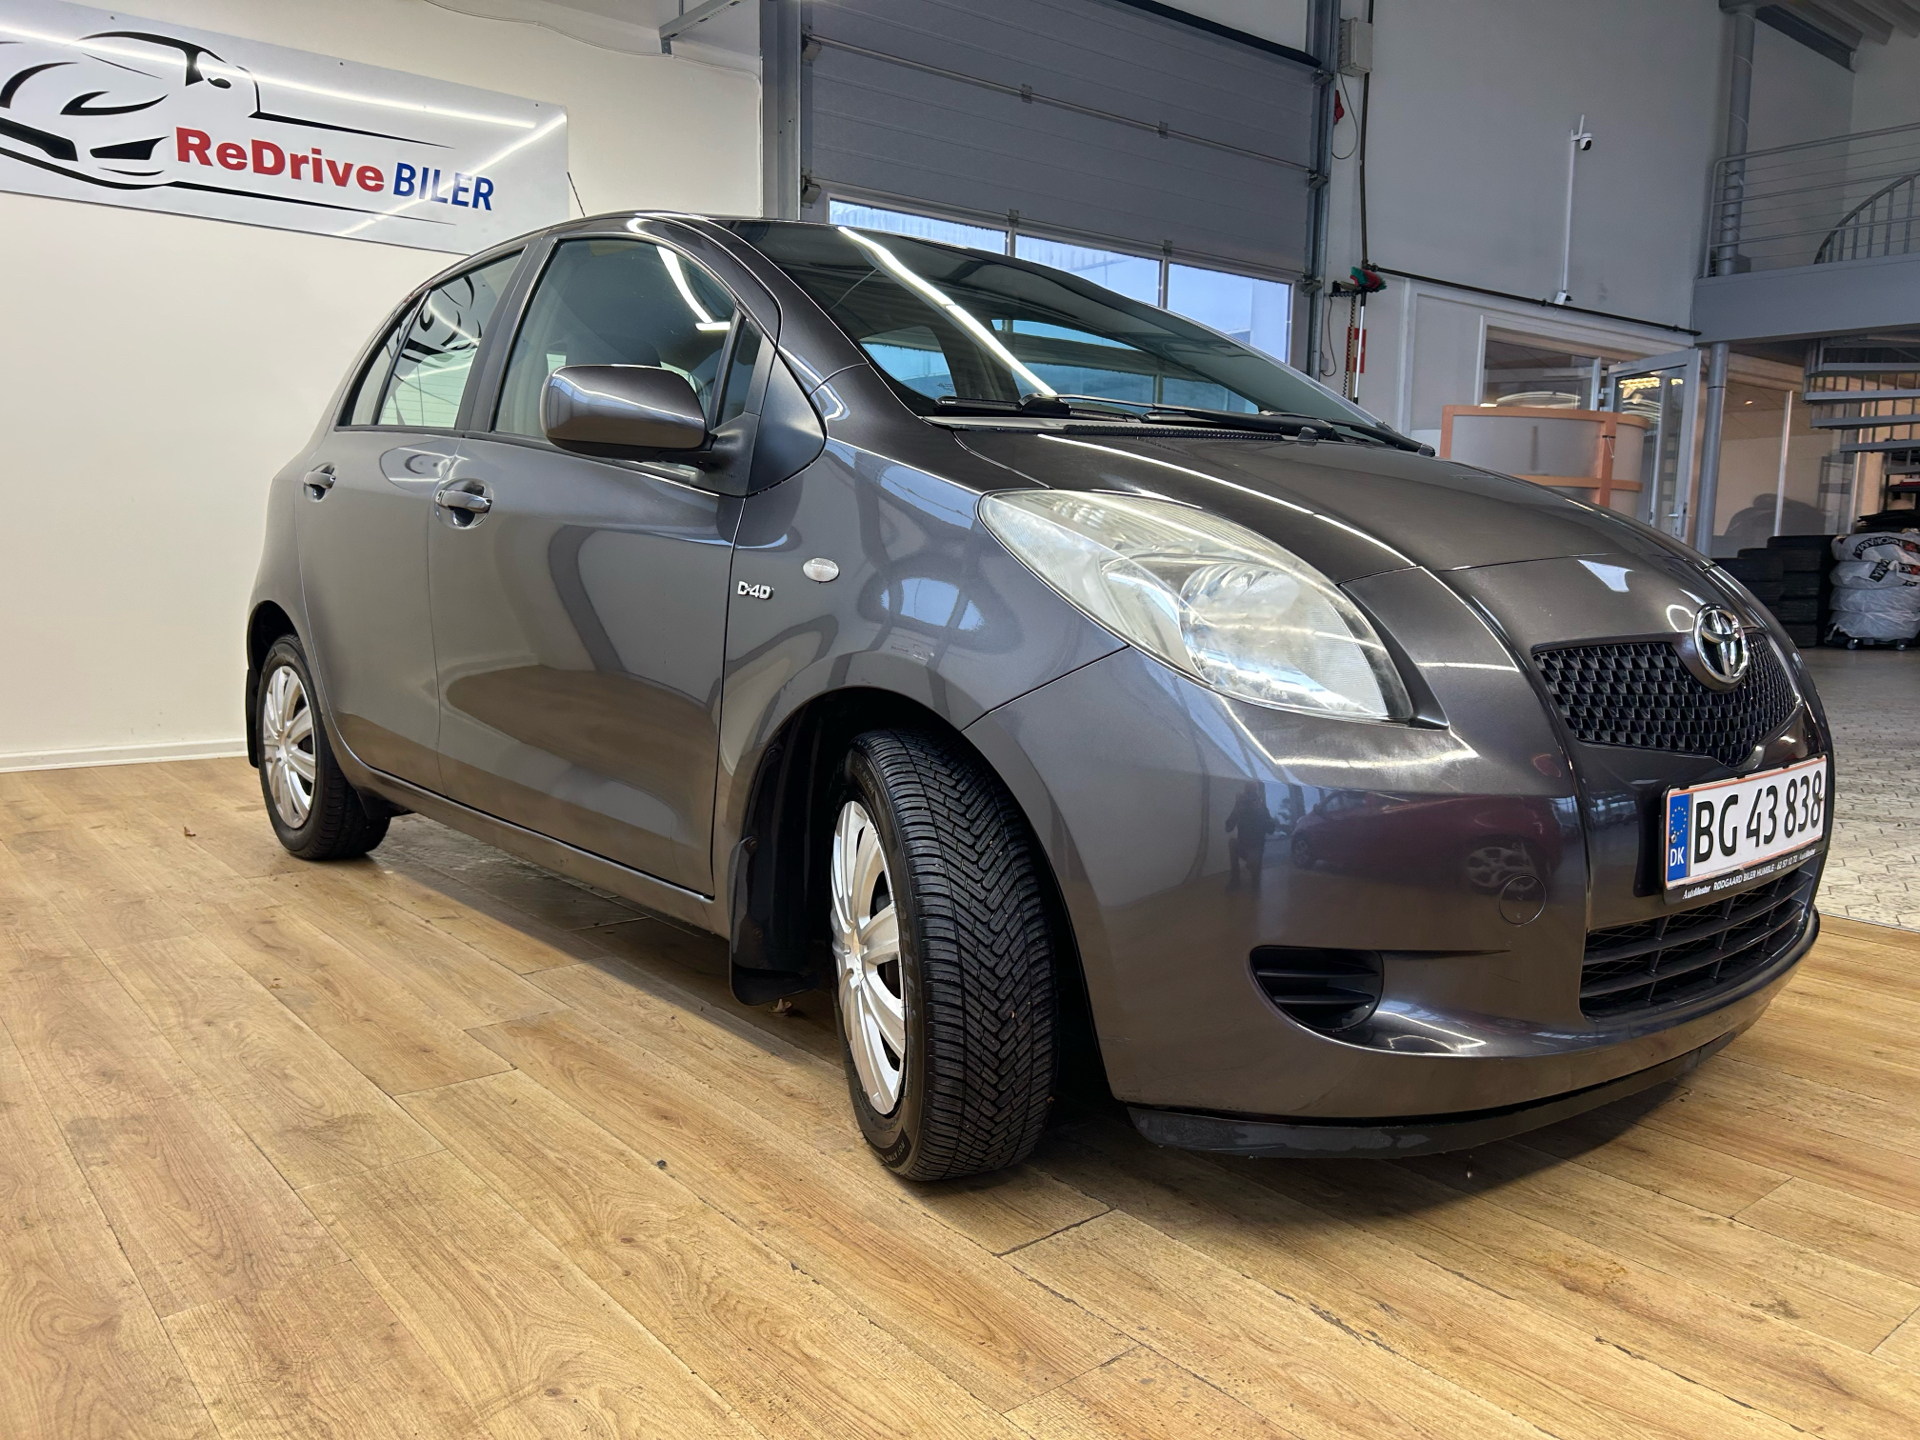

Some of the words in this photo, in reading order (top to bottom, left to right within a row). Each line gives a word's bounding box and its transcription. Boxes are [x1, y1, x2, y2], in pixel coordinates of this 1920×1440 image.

[175, 126, 385, 193] ReDrive
[393, 161, 495, 211] BILER
[1669, 846, 1685, 867] DK
[1694, 793, 1739, 864] BG
[1746, 785, 1778, 848] 43
[1784, 769, 1822, 839] 838
